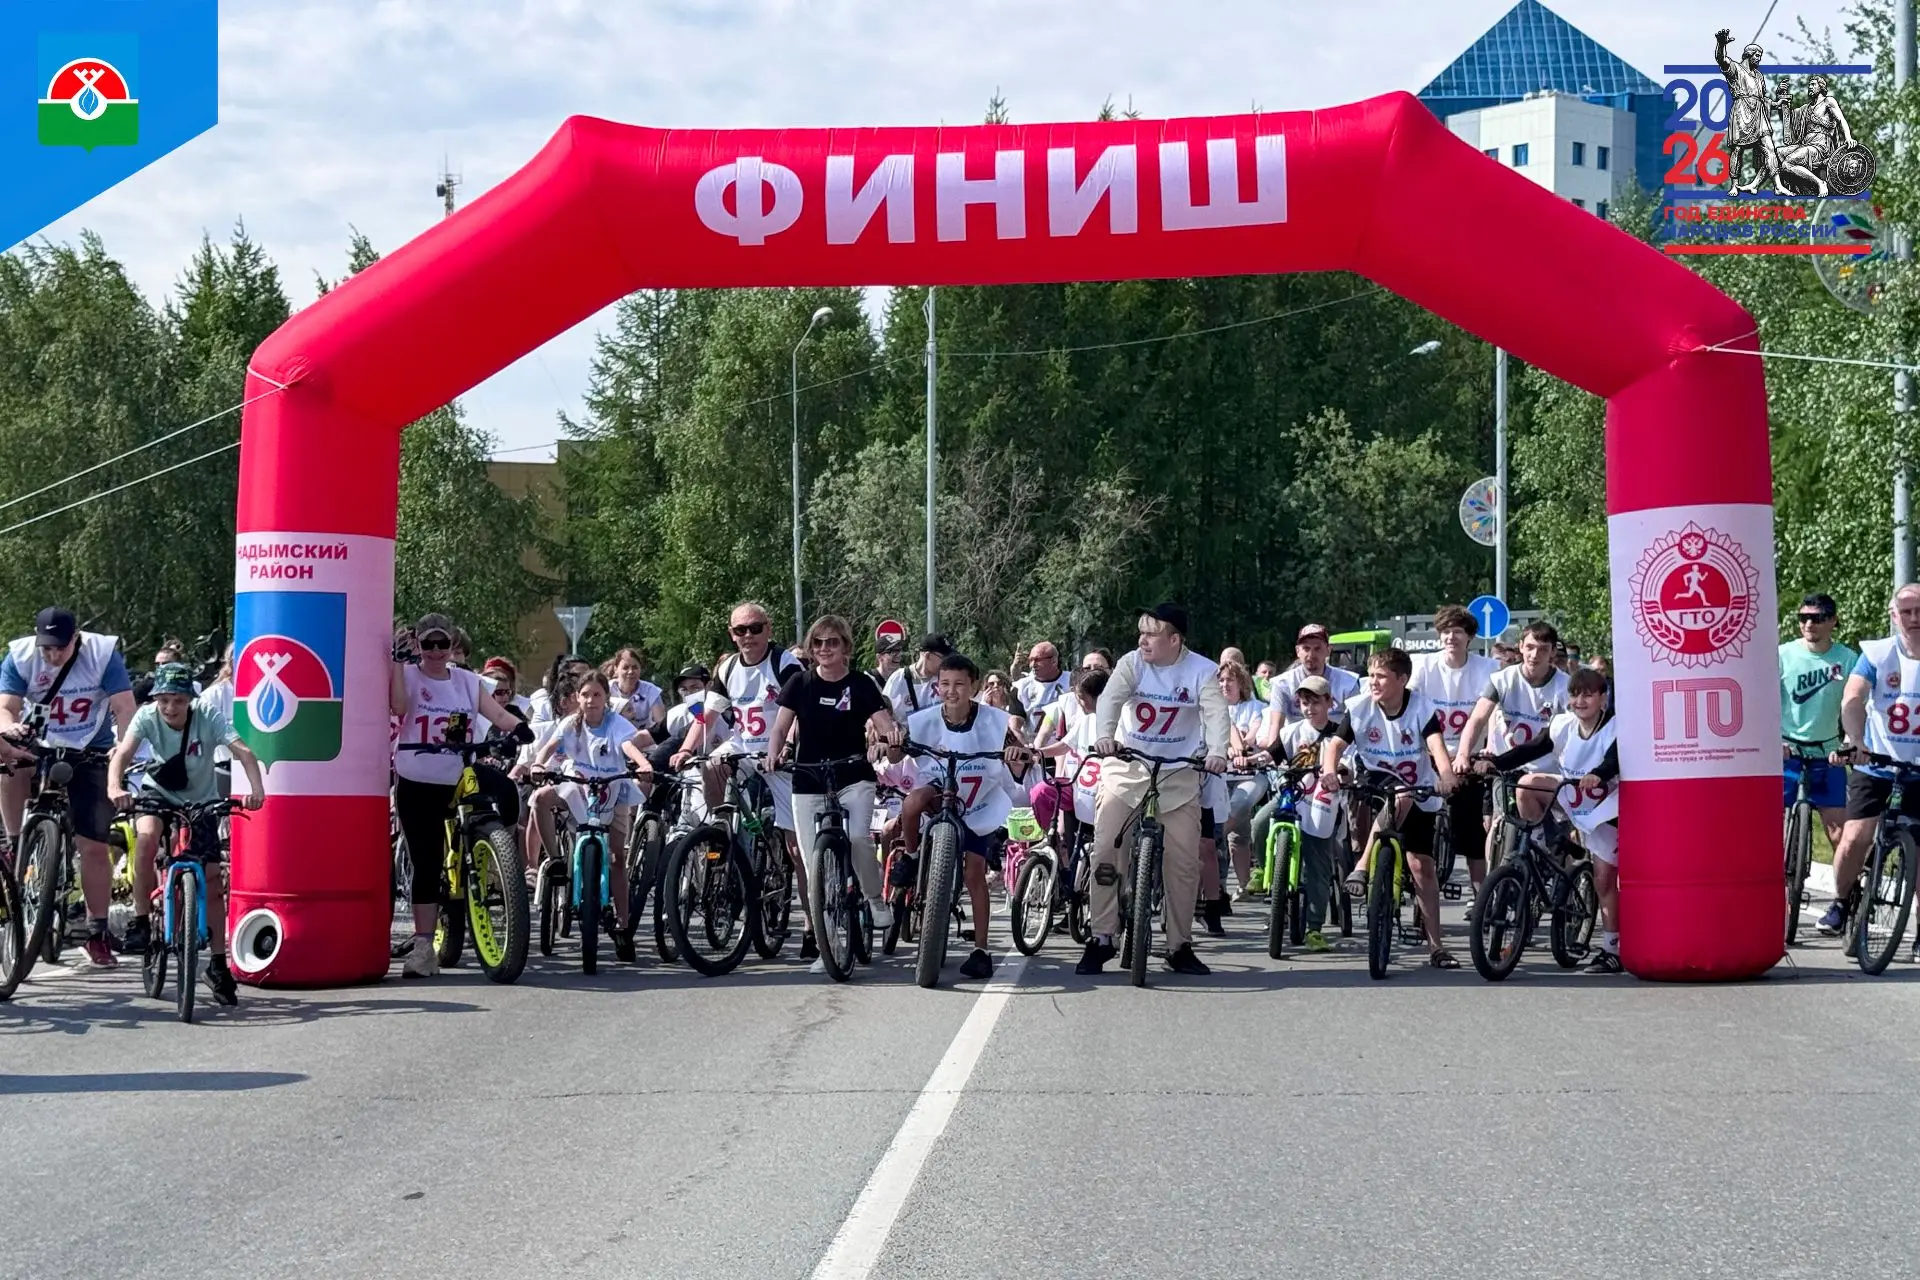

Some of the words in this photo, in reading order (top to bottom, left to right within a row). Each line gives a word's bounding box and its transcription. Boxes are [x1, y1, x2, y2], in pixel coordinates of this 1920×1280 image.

[694, 134, 1288, 246] ФИНИШ
[250, 562, 313, 579] РАЙОН
[1680, 610, 1715, 625] ГТО
[1797, 667, 1829, 691] RUN
[50, 696, 93, 725] 49
[1135, 702, 1180, 735] 97
[1653, 677, 1743, 740] ГТО
[961, 776, 983, 808] 7
